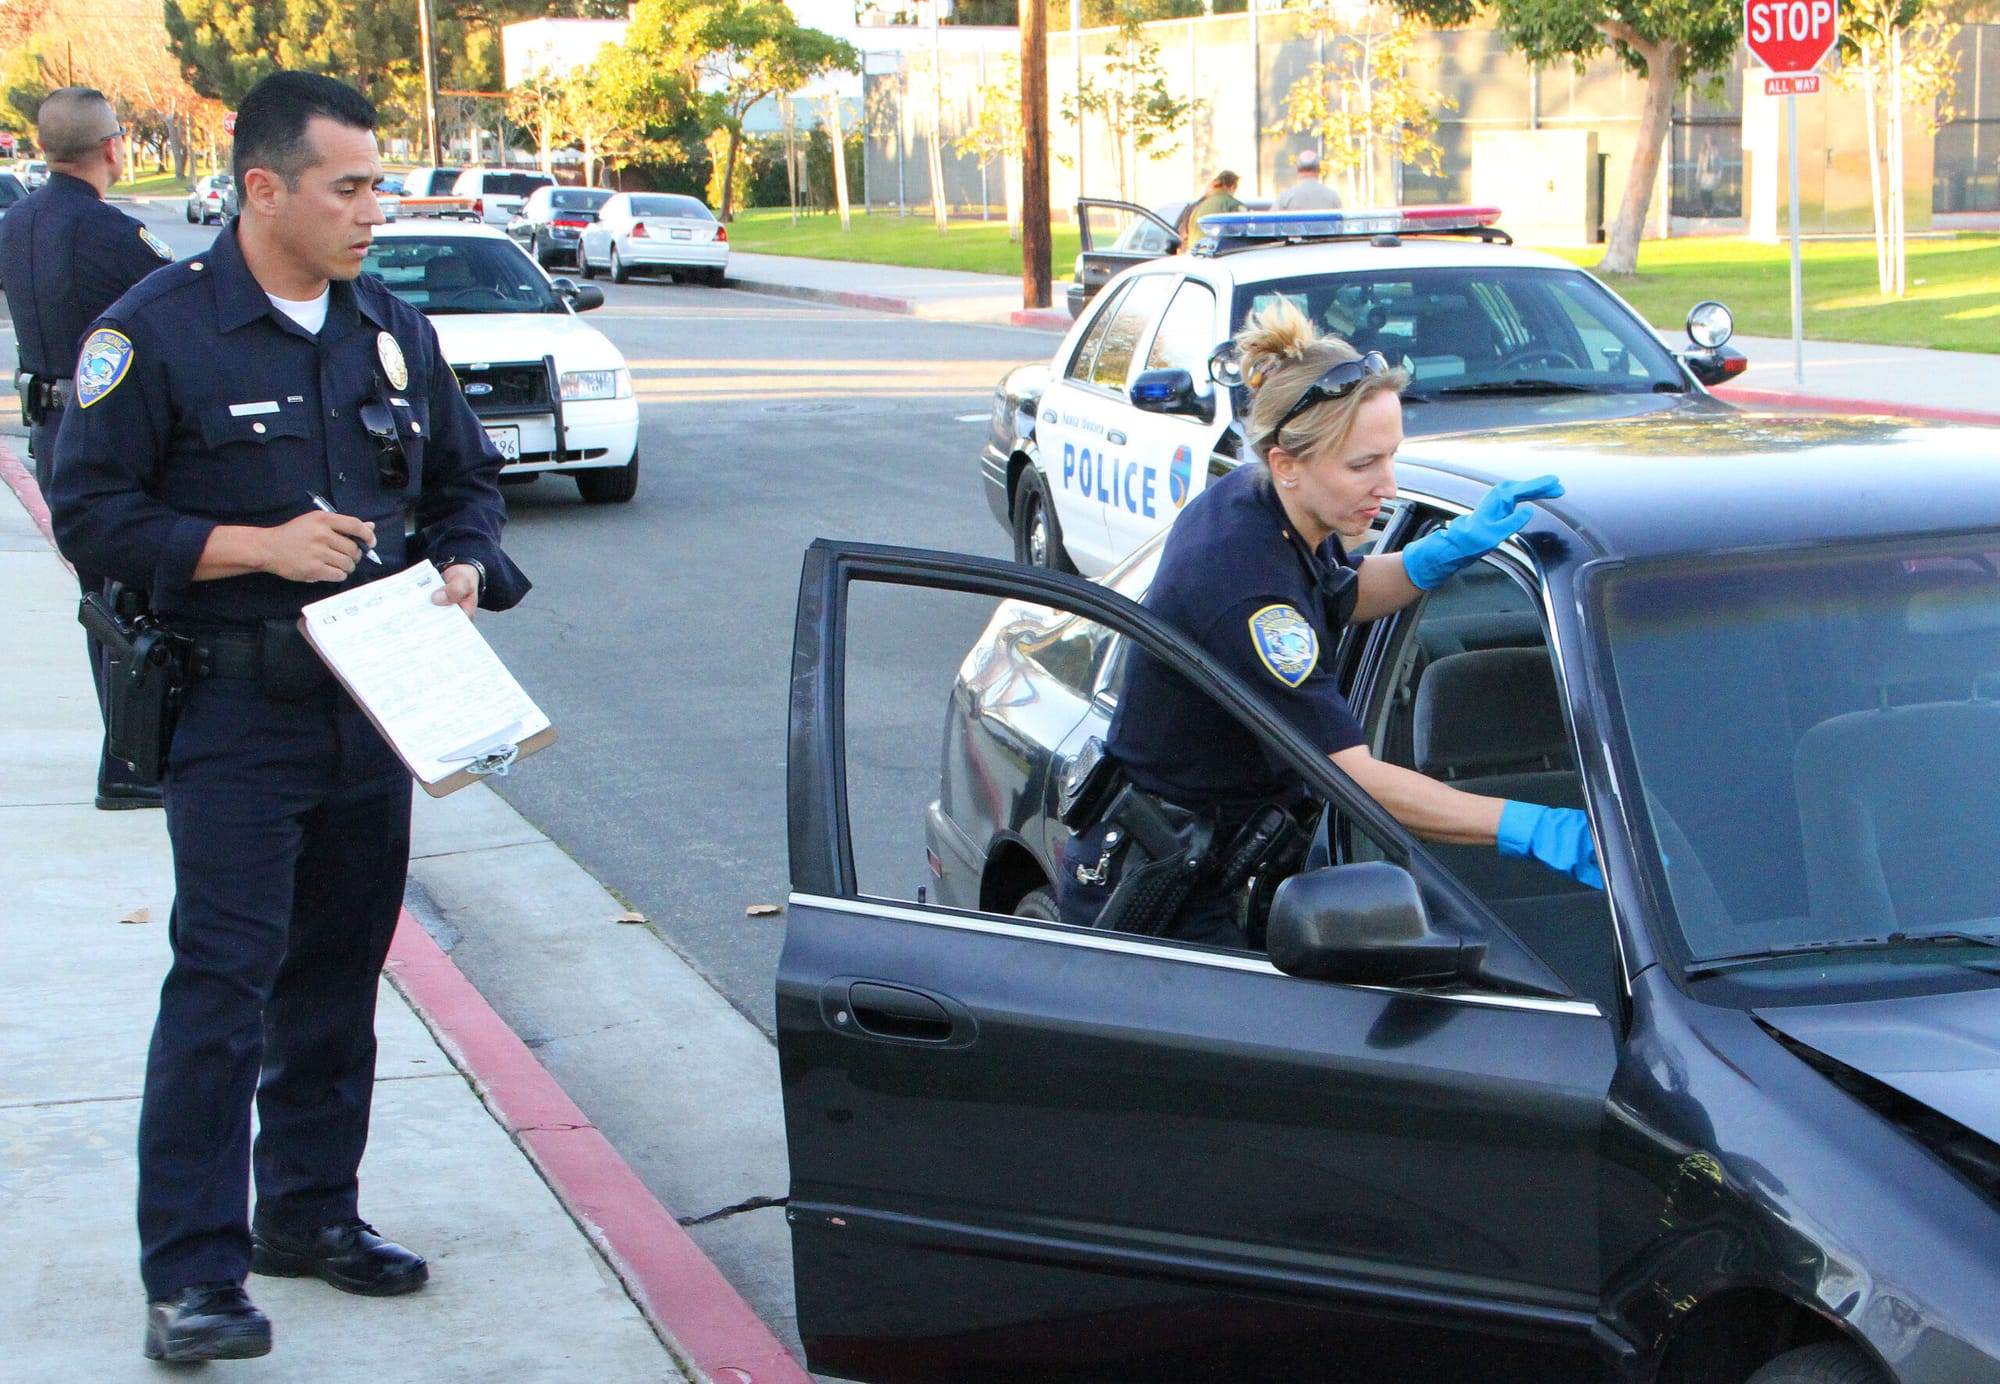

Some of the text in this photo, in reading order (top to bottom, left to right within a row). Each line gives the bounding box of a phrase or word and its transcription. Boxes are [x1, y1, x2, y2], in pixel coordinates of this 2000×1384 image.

[1752, 1, 1831, 43] STOP
[1768, 78, 1817, 93] ALL WAY
[224, 119, 236, 130] ST
[492, 440, 515, 454] 96
[1064, 442, 1157, 519] POLICE
